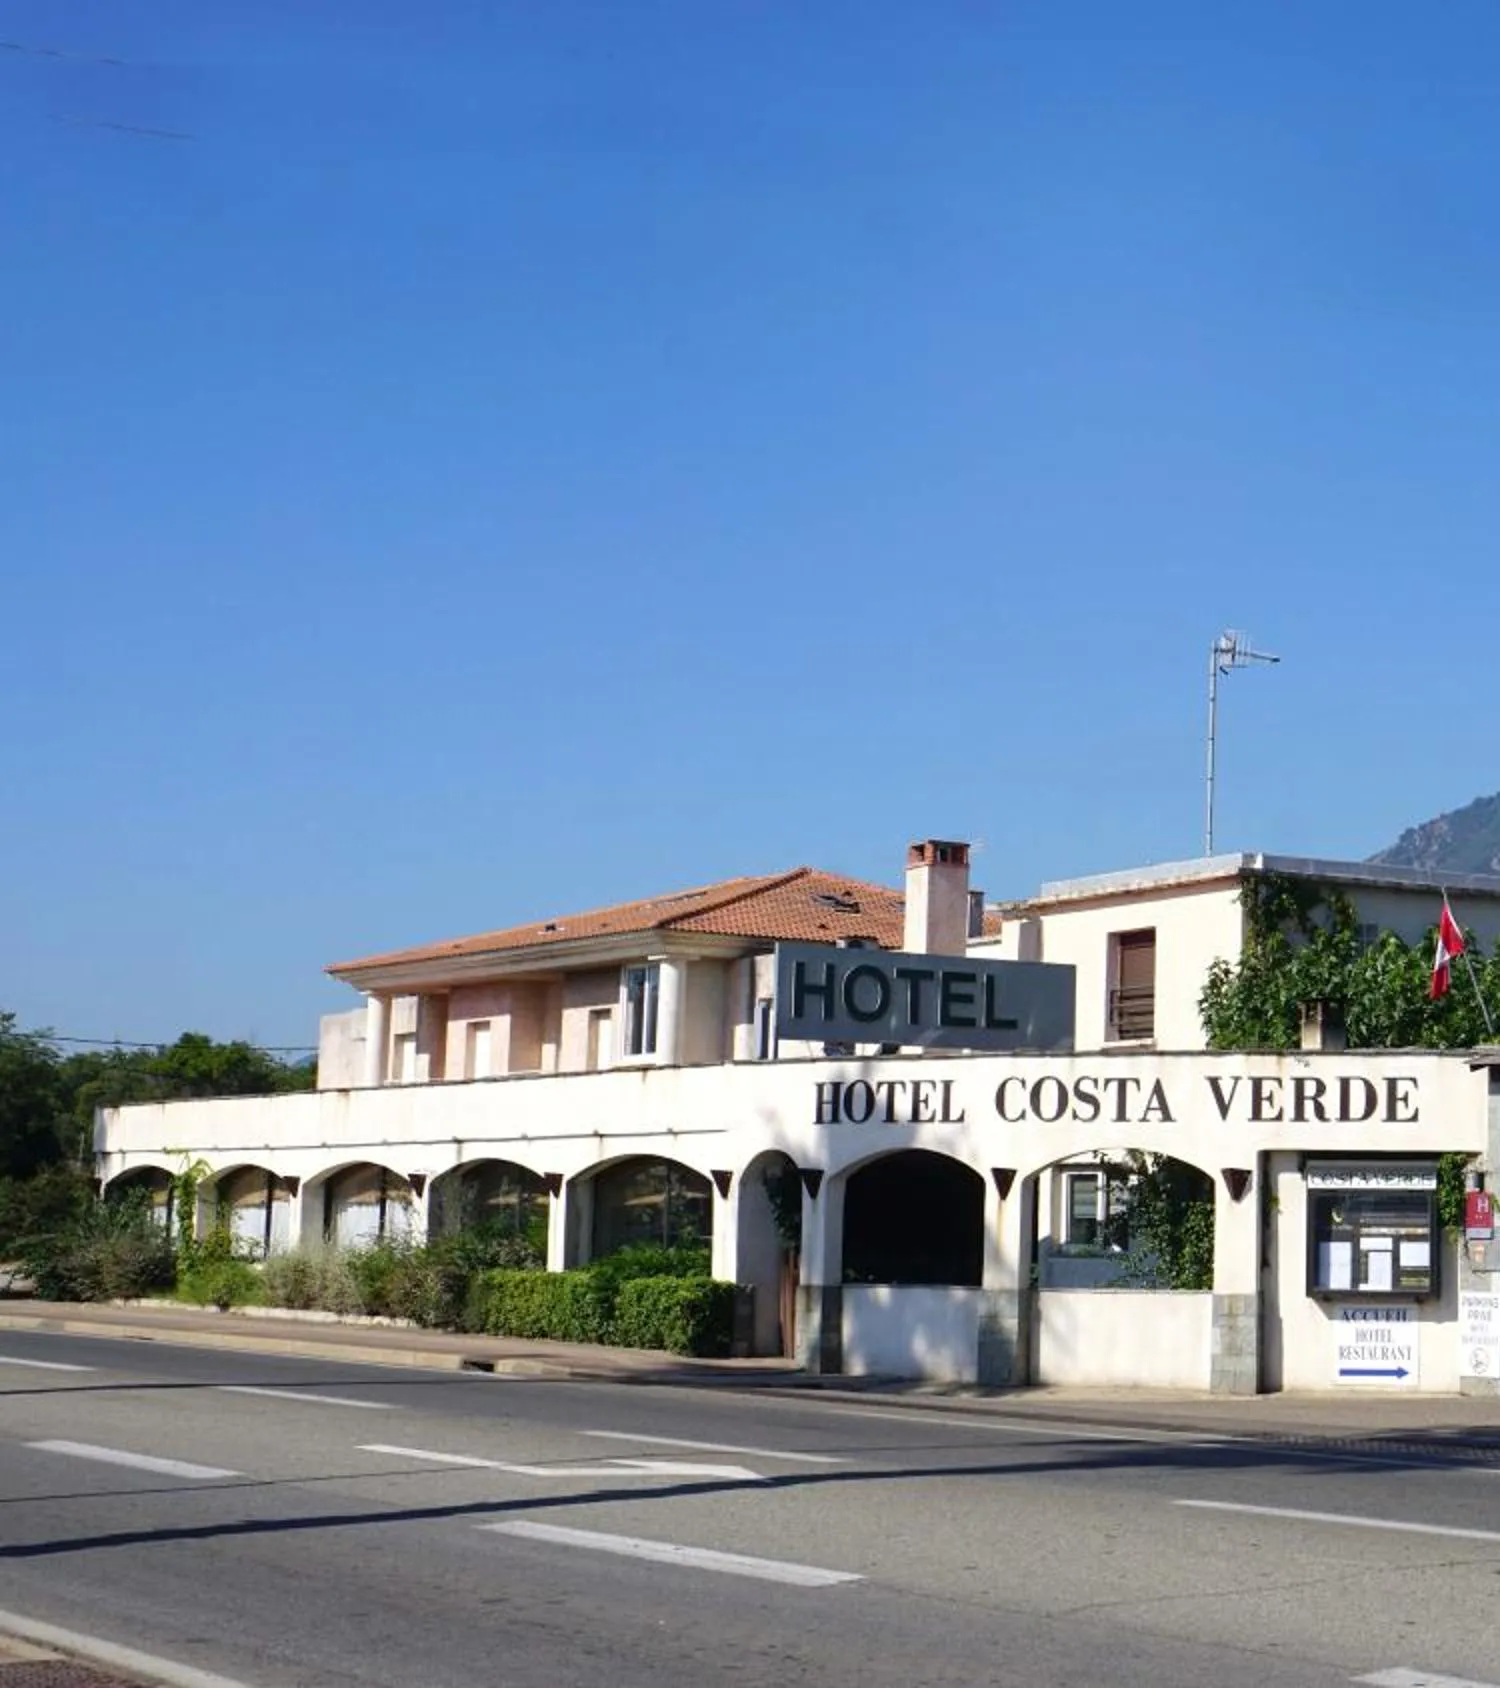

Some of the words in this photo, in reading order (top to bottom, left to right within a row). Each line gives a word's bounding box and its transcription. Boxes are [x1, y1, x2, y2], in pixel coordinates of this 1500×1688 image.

[791, 959, 1019, 1030] HOTEL
[813, 1078, 966, 1125] HOTEL
[995, 1075, 1177, 1123] COSTA
[1204, 1075, 1420, 1123] VERDE
[1477, 1198, 1489, 1212] H
[1343, 1308, 1408, 1322] ACCUEIL
[1339, 1345, 1411, 1361] RESTAURANT
